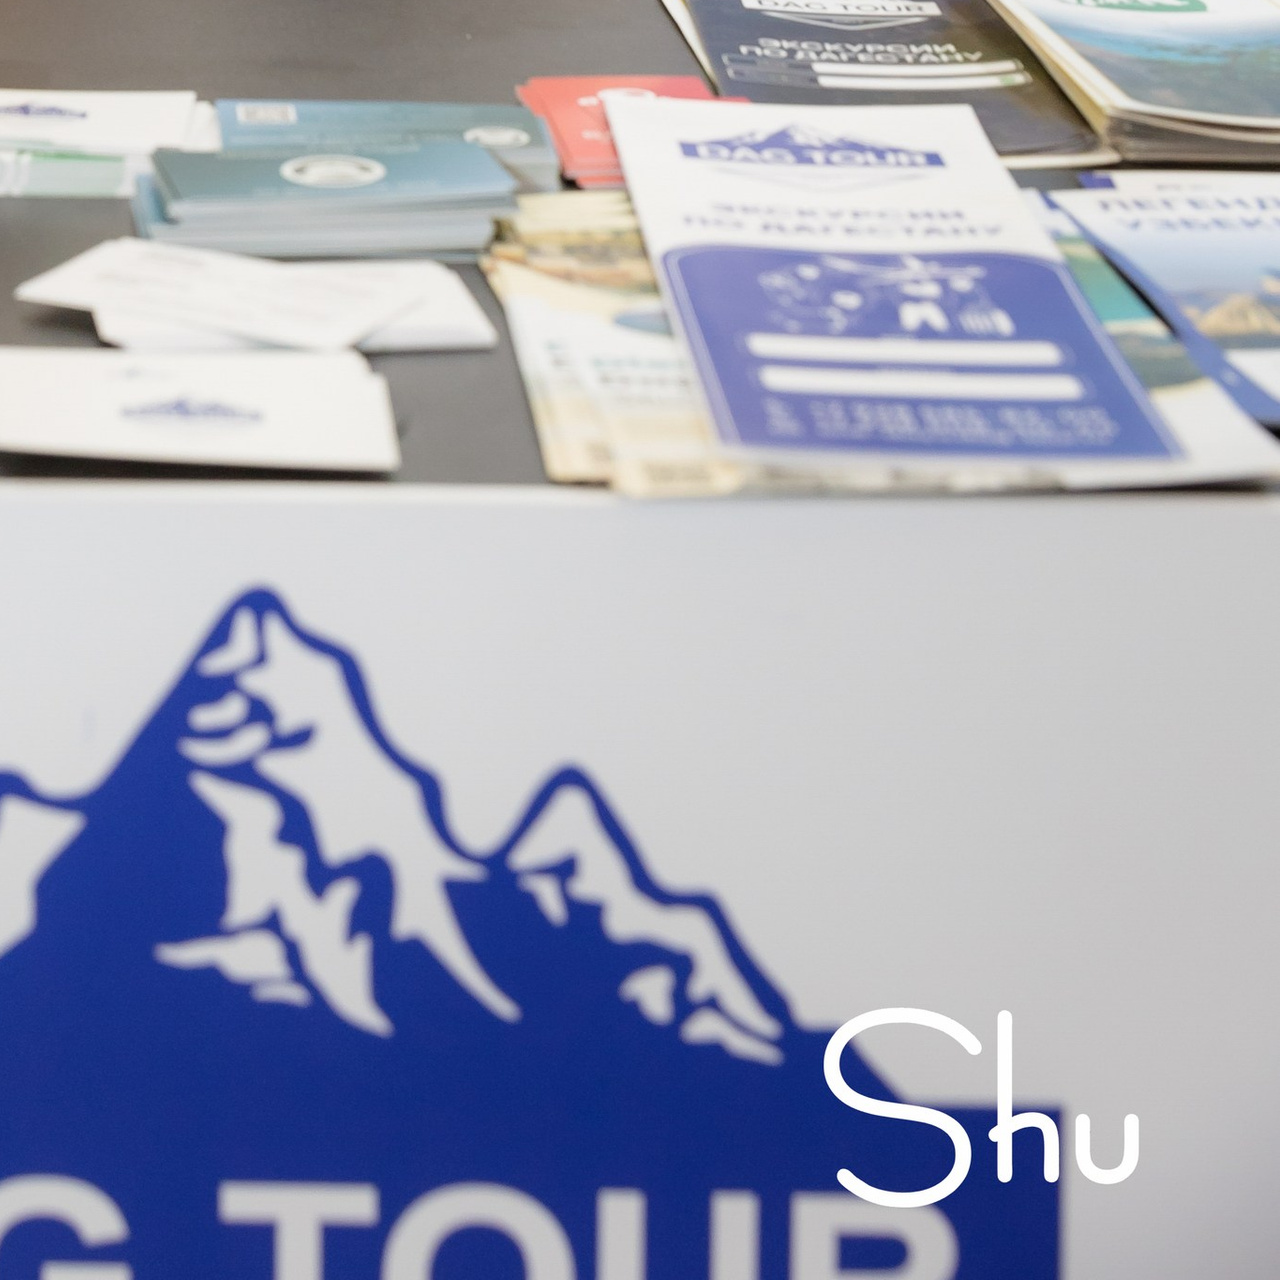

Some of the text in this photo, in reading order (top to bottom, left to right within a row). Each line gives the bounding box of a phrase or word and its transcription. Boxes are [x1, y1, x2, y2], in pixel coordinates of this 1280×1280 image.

[756, 0, 925, 13] DAG TOUR
[738, 44, 983, 64] ПО ДАГЕСТАНУ
[757, 37, 957, 54] ЭКСКУРСИИ
[696, 143, 927, 167] DAG TOUR
